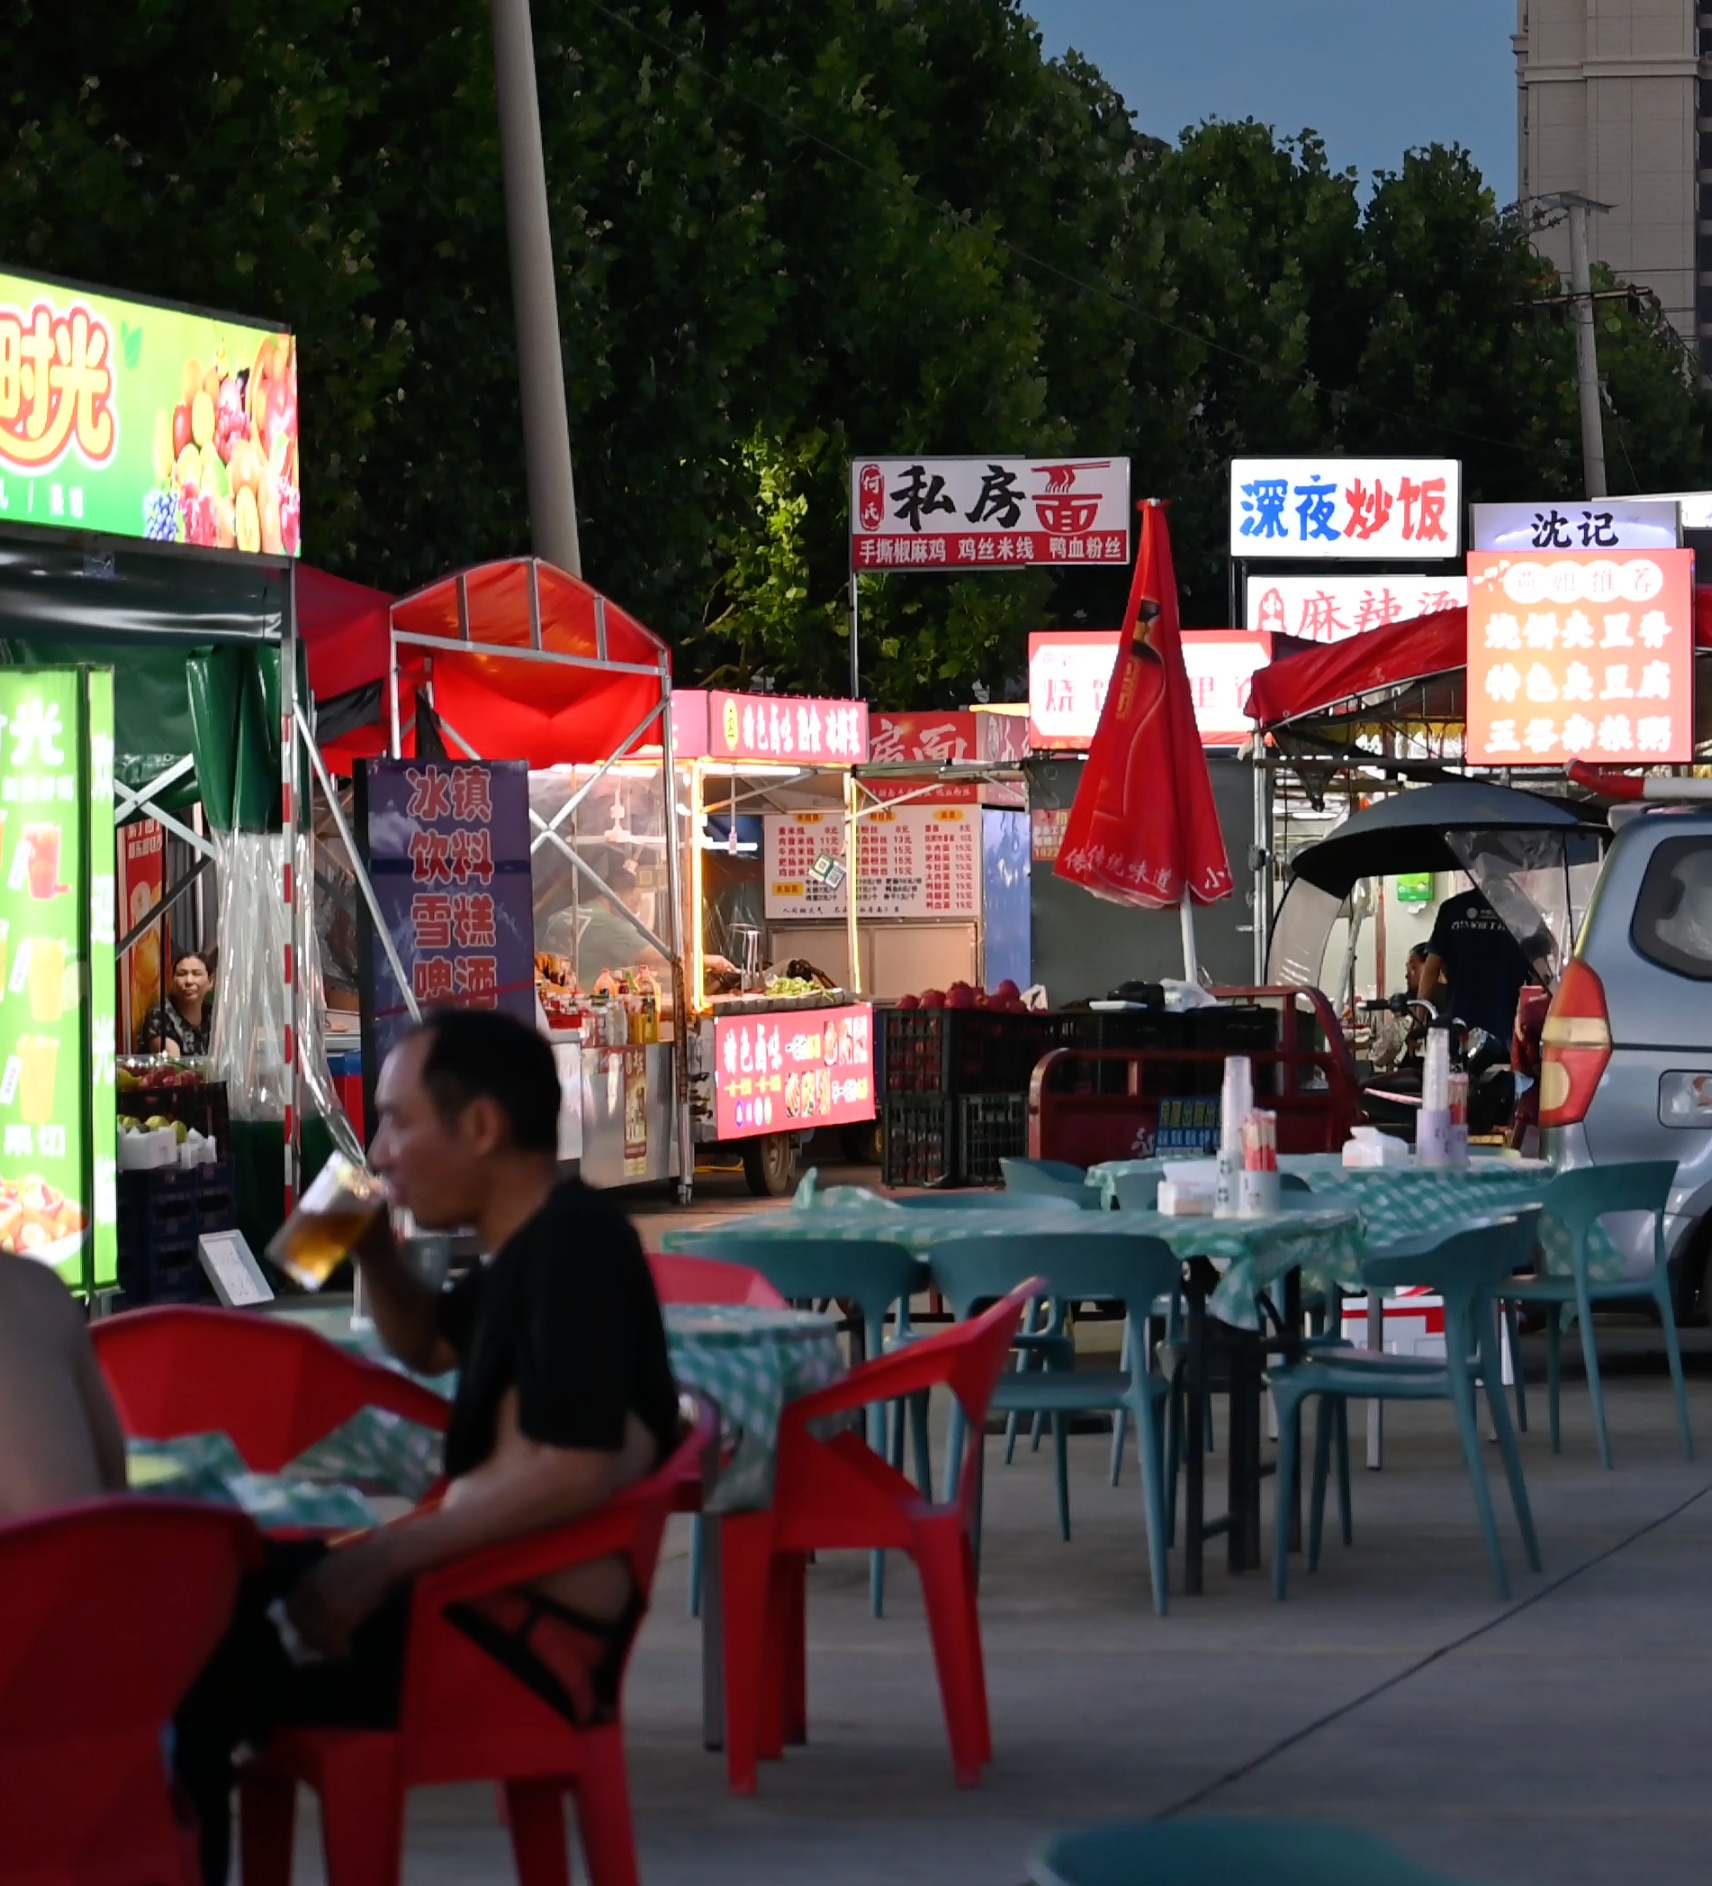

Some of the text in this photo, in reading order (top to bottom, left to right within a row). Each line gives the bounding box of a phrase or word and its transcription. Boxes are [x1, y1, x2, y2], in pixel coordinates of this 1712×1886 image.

[862, 474, 881, 521] 何氏
[1239, 474, 1449, 541] 深夜炒饭
[859, 535, 1121, 563] 手撕椒麻鸡 鸡丝米线 鸭血粉丝
[1531, 510, 1620, 548] 沈记
[0, 697, 65, 766] 光
[406, 764, 493, 823] 冰镇
[408, 828, 495, 885] 饮料
[411, 893, 497, 948] 雪糕
[412, 955, 498, 1010] 啤酒
